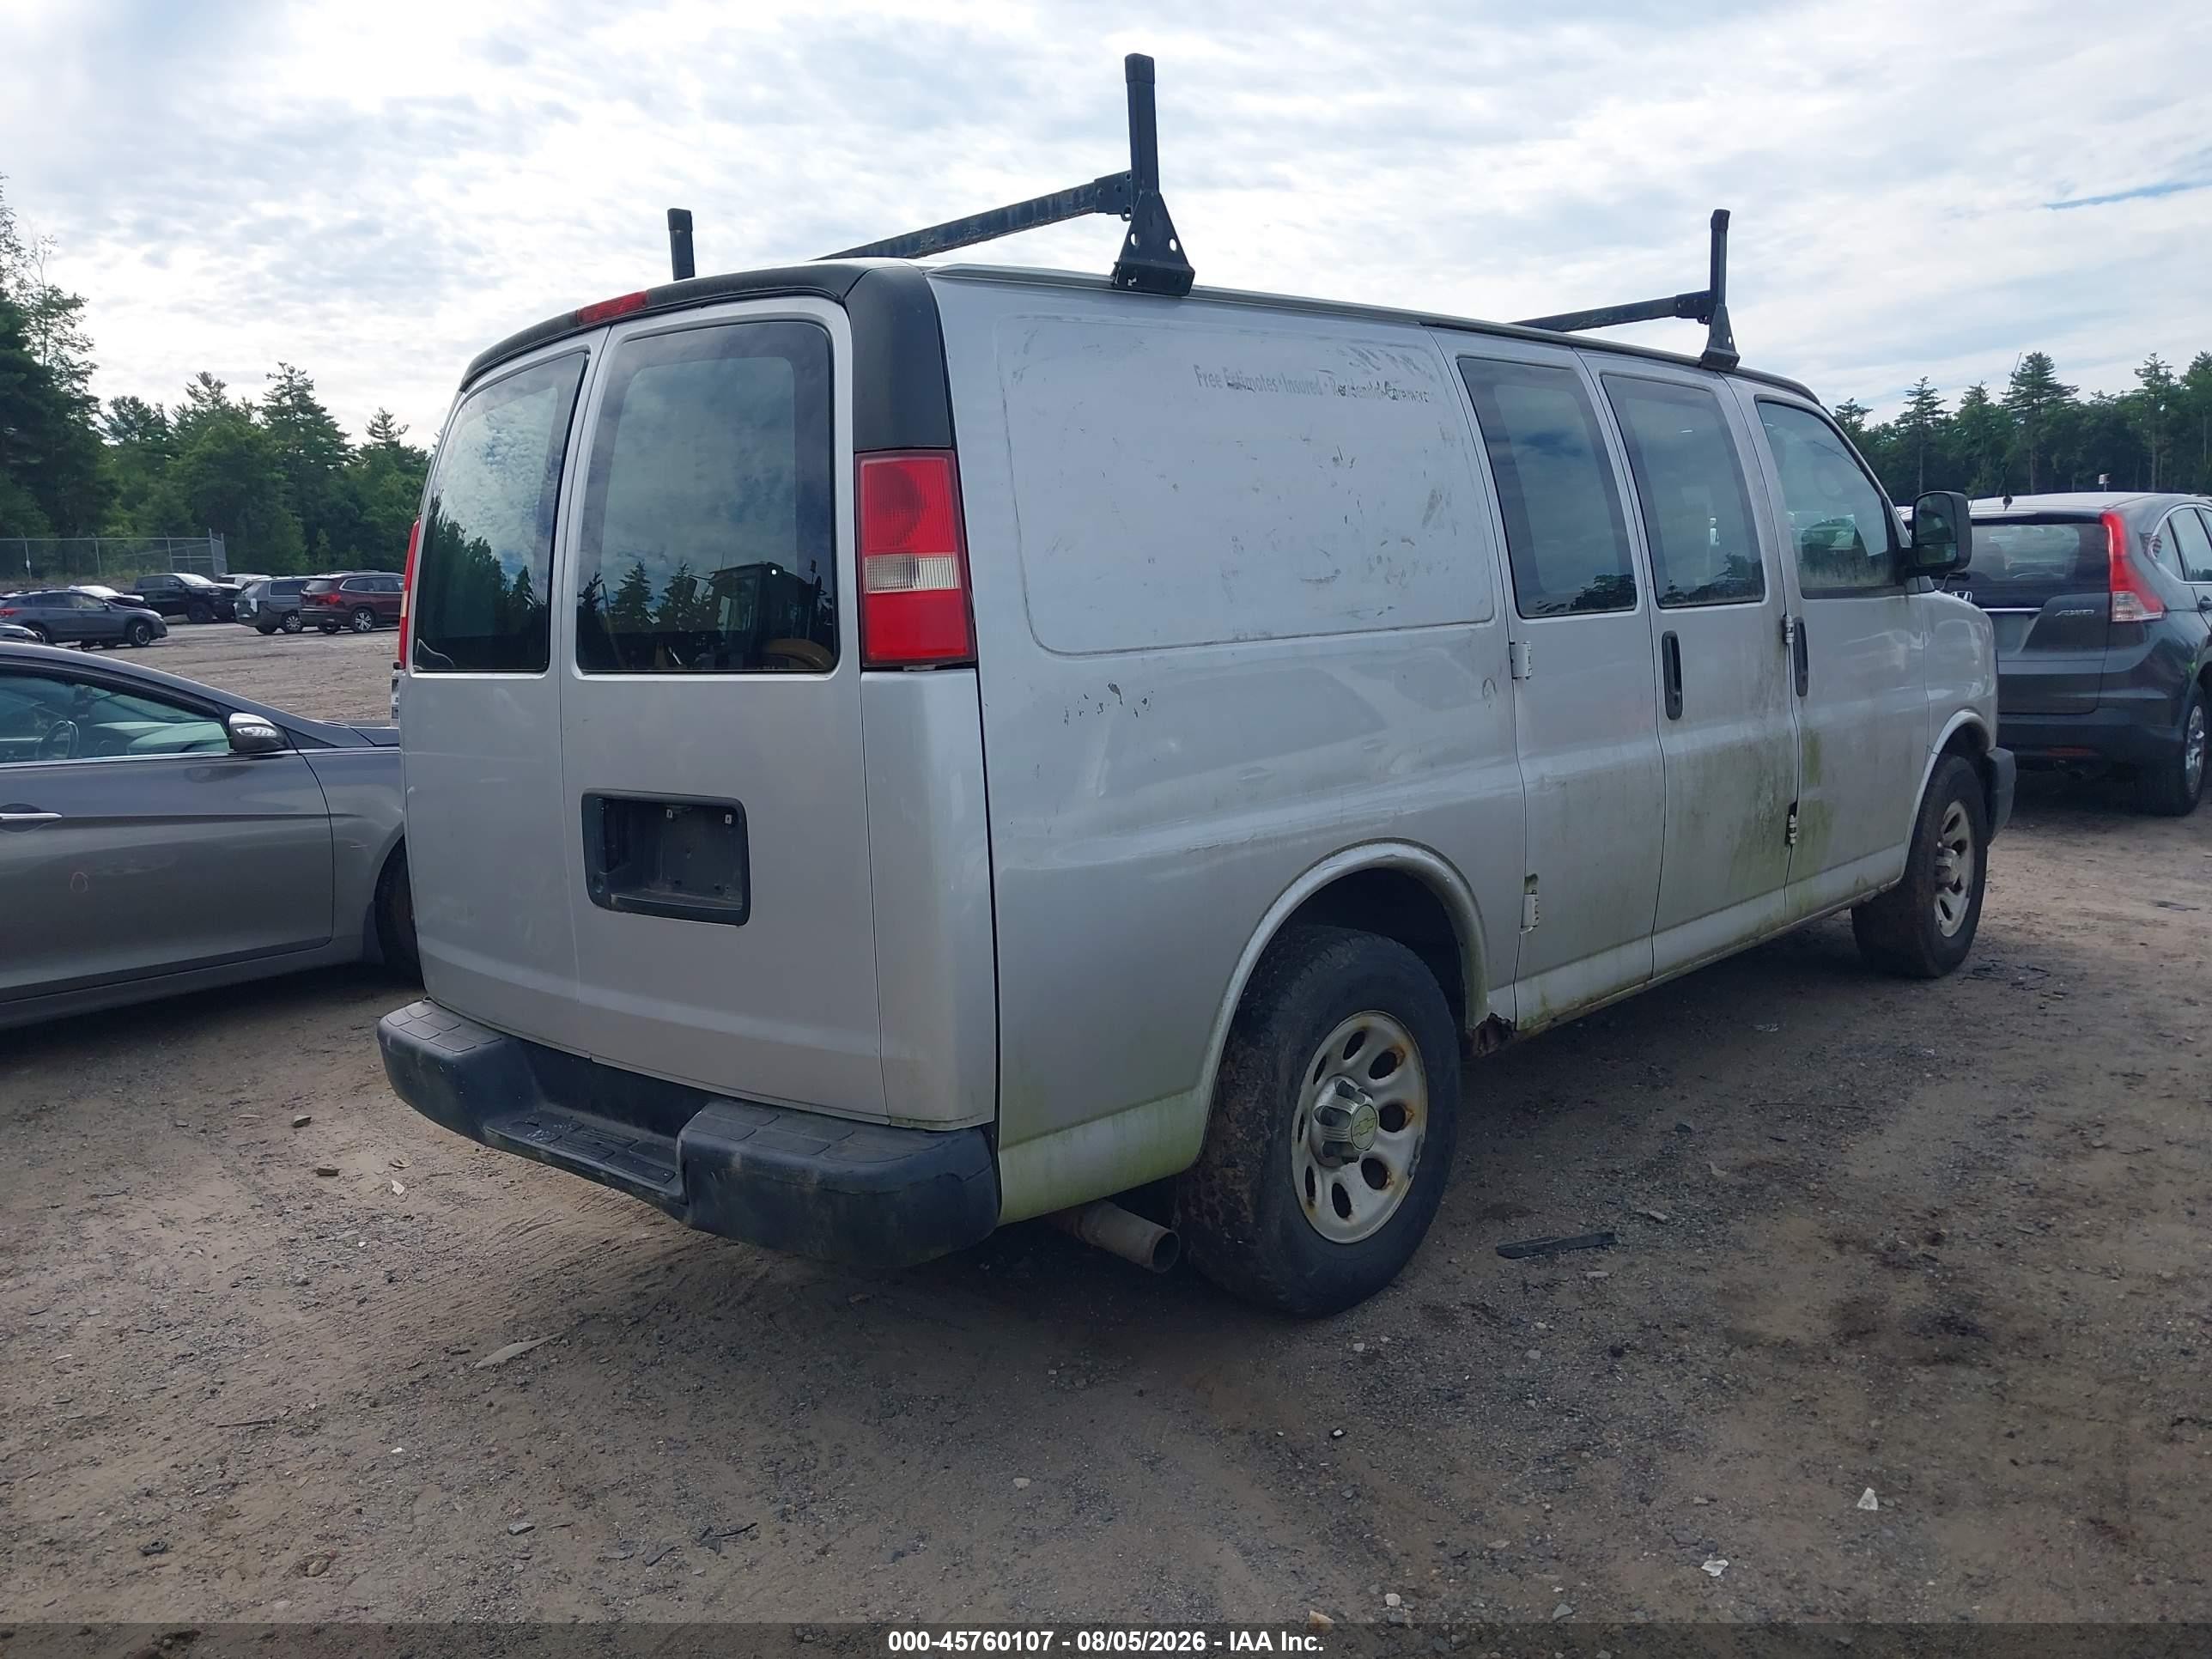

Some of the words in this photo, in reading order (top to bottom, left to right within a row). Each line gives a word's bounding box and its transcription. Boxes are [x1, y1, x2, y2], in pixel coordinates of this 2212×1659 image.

[1194, 364, 1223, 389] Free
[1222, 367, 1279, 392] Estimates
[1280, 372, 1323, 396] Insured
